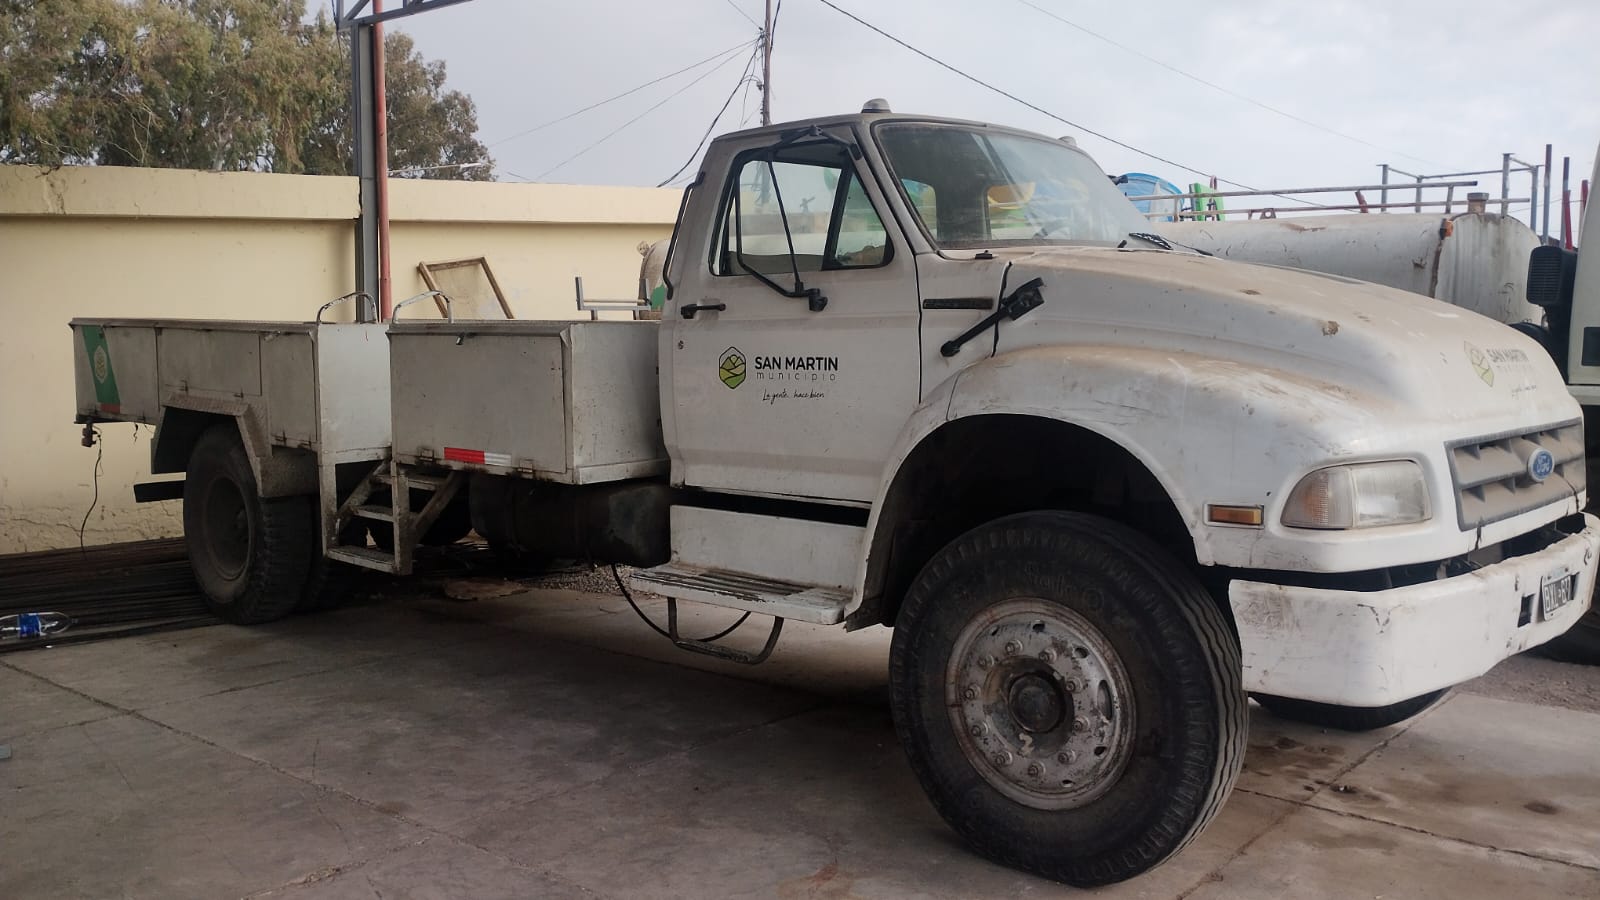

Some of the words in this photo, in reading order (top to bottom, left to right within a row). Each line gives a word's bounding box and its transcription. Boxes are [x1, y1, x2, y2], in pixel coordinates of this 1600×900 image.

[755, 356, 781, 370] SAN
[785, 357, 838, 371] MARTIN
[756, 371, 836, 382] municipio
